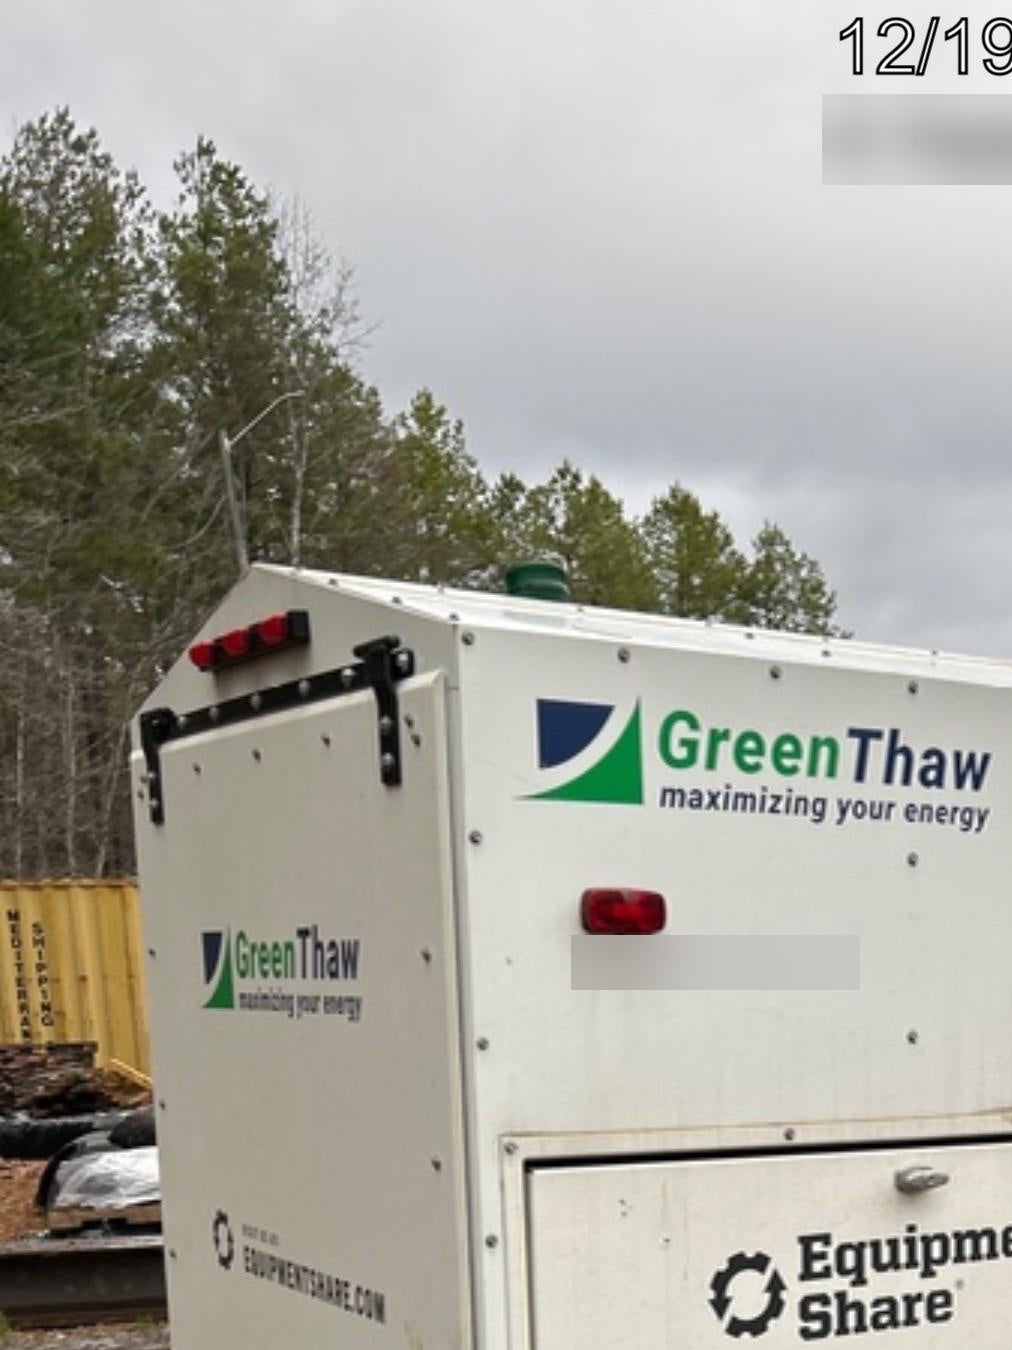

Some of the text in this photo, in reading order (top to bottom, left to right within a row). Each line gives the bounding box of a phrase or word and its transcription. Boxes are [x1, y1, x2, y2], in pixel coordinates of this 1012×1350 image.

[658, 710, 991, 792] GreenThaw
[659, 784, 991, 834] maximizing your energy
[32, 922, 54, 1026] SHIPPING
[235, 924, 360, 980] GreenThaw
[243, 1246, 386, 1324] EQUIPMENTSHARE.COM
[798, 1288, 954, 1341] Share
